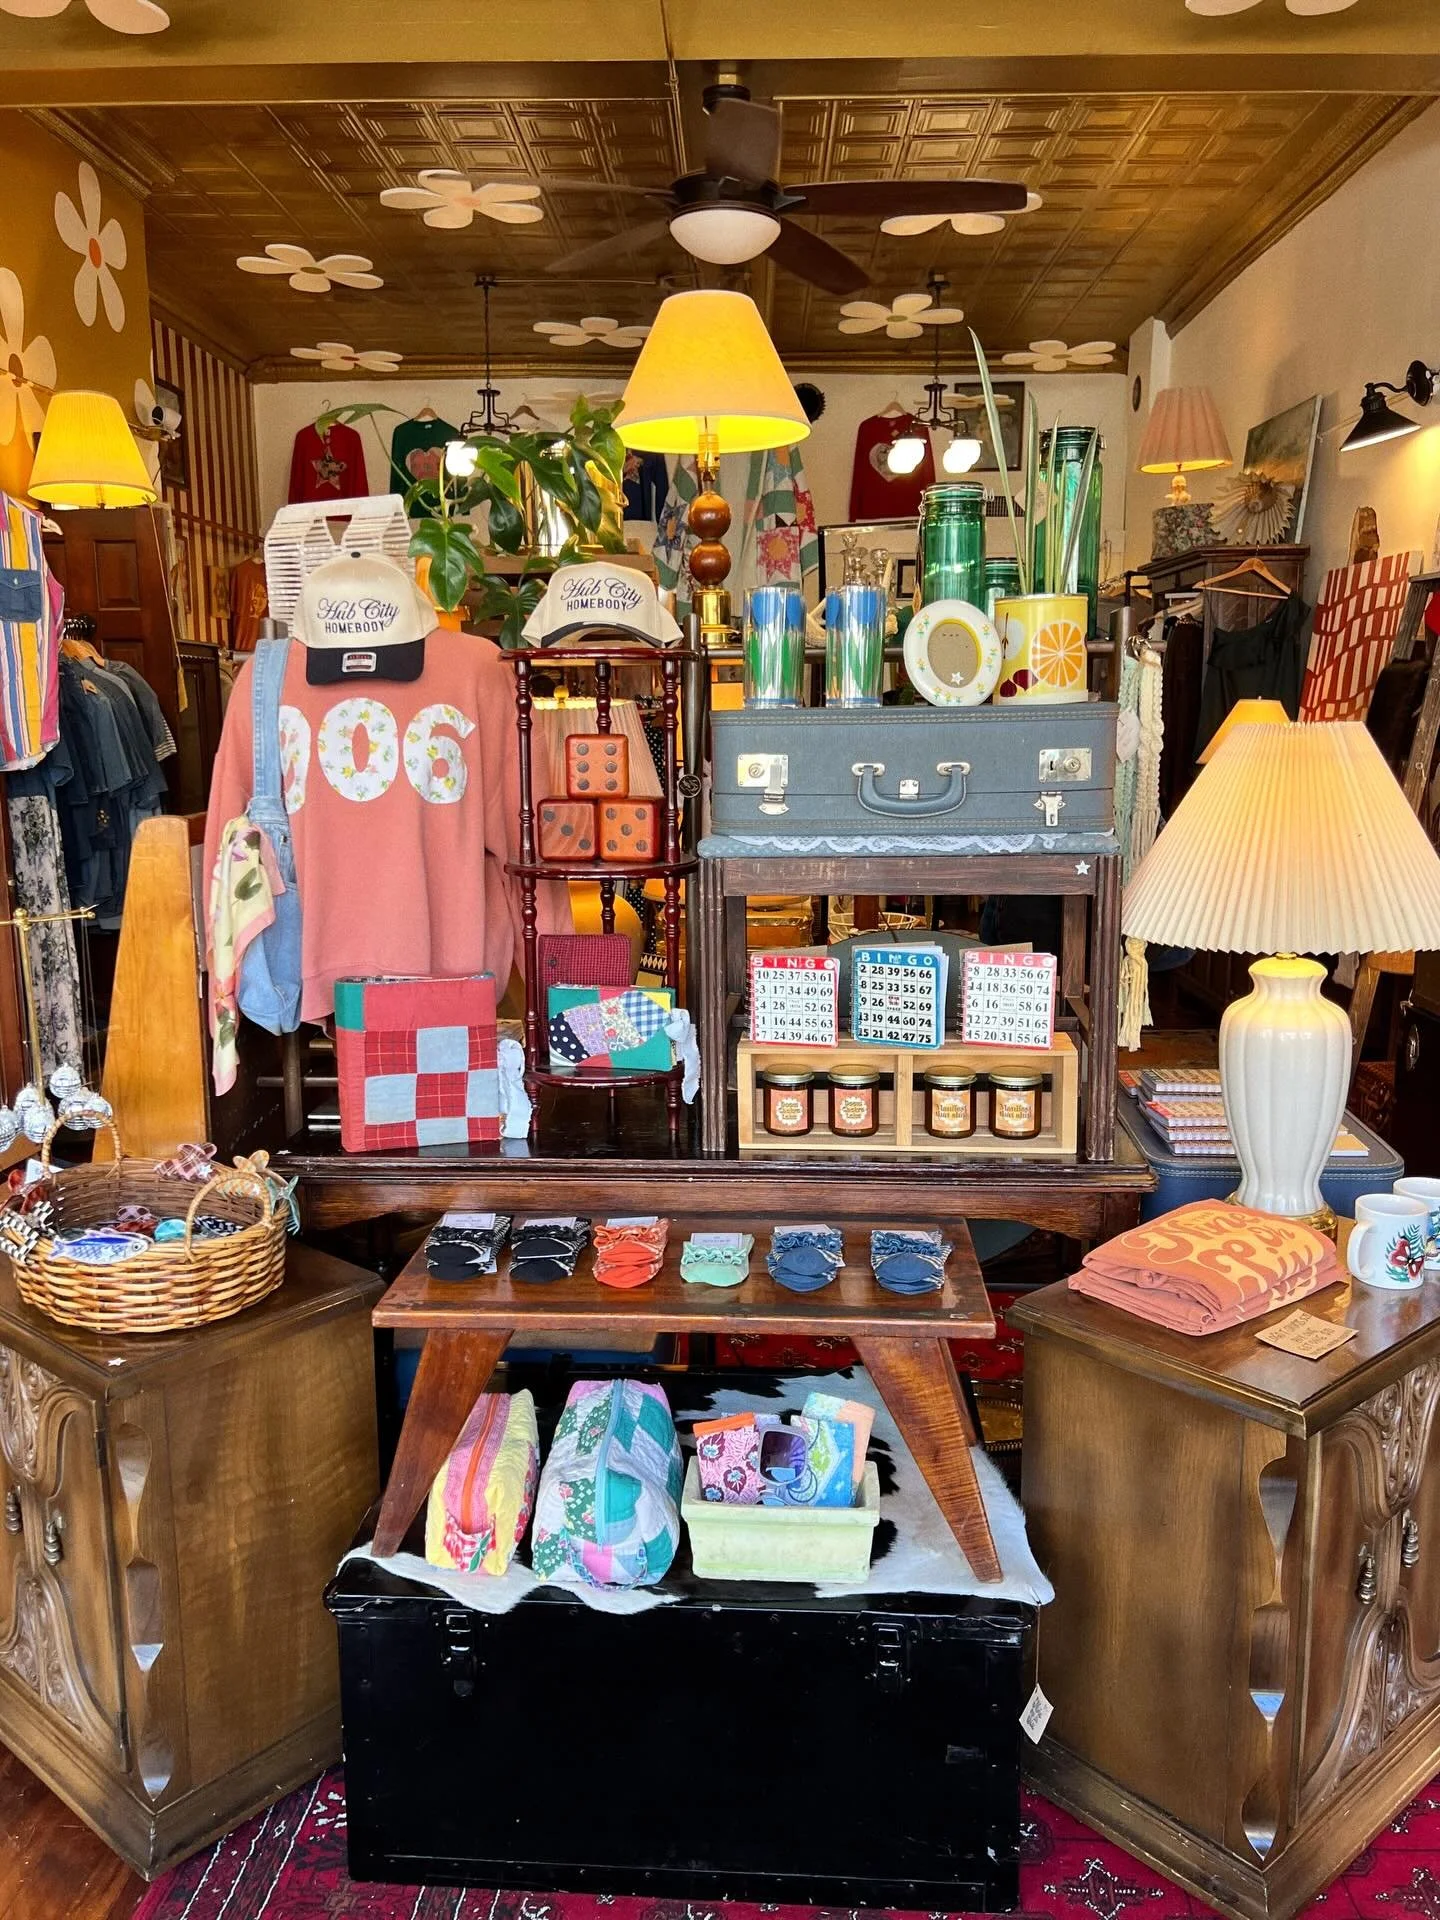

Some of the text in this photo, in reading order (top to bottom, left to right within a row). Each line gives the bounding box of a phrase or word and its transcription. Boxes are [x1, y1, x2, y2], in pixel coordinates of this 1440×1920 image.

[560, 578, 643, 609] Hub City
[567, 598, 627, 611] HOMEBODY
[317, 598, 399, 627] Hub City
[325, 620, 384, 633] HOMEBODY
[862, 952, 932, 965] BINGO
[757, 971, 832, 982] 10 25 37 53 61
[872, 966, 884, 975] 28
[888, 967, 900, 976] 39
[903, 968, 916, 977] 56
[919, 970, 932, 978] 66
[987, 967, 1000, 976] 28
[1003, 968, 1016, 978] 33
[1020, 969, 1033, 979] 56
[1037, 970, 1050, 980] 67
[774, 986, 785, 994] 17
[788, 986, 801, 995] 34
[804, 987, 816, 996] 49
[820, 987, 832, 996] 69
[872, 982, 884, 990] 25
[888, 983, 900, 992] 33
[903, 984, 915, 993] 55
[919, 986, 932, 995] 67
[987, 983, 999, 992] 18
[1002, 984, 1016, 993] 36
[1019, 984, 1032, 994] 50
[1037, 986, 1049, 995] 74
[773, 1001, 785, 1010] 28
[805, 1003, 816, 1012] 52
[821, 1004, 832, 1012] 62
[872, 998, 884, 1006] 26
[903, 1001, 915, 1010] 52
[919, 1002, 931, 1011] 69
[986, 999, 998, 1009] 16
[1019, 1002, 1031, 1011] 58
[1035, 1002, 1048, 1012] 61
[774, 1017, 785, 1026] 16
[789, 1018, 801, 1026] 44
[805, 1019, 817, 1027] 55
[821, 1019, 833, 1029] 63
[872, 1014, 883, 1022] 19
[888, 1015, 900, 1024] 44
[903, 1017, 915, 1026] 60
[919, 1018, 932, 1027] 74
[985, 1016, 997, 1024] 27
[1000, 1017, 1014, 1026] 39
[1018, 1018, 1030, 1028] 51
[1035, 1019, 1048, 1028] 65
[774, 1031, 785, 1040] 24
[789, 1032, 801, 1041] 39
[805, 1033, 817, 1042] 46
[821, 1034, 833, 1042] 67
[873, 1030, 883, 1038] 21
[888, 1031, 899, 1040] 42
[903, 1033, 915, 1041] 47
[919, 1034, 931, 1043] 75
[984, 1031, 997, 1040] 20
[1000, 1032, 1012, 1042] 31
[1017, 1033, 1030, 1043] 55
[1034, 1035, 1047, 1044] 64
